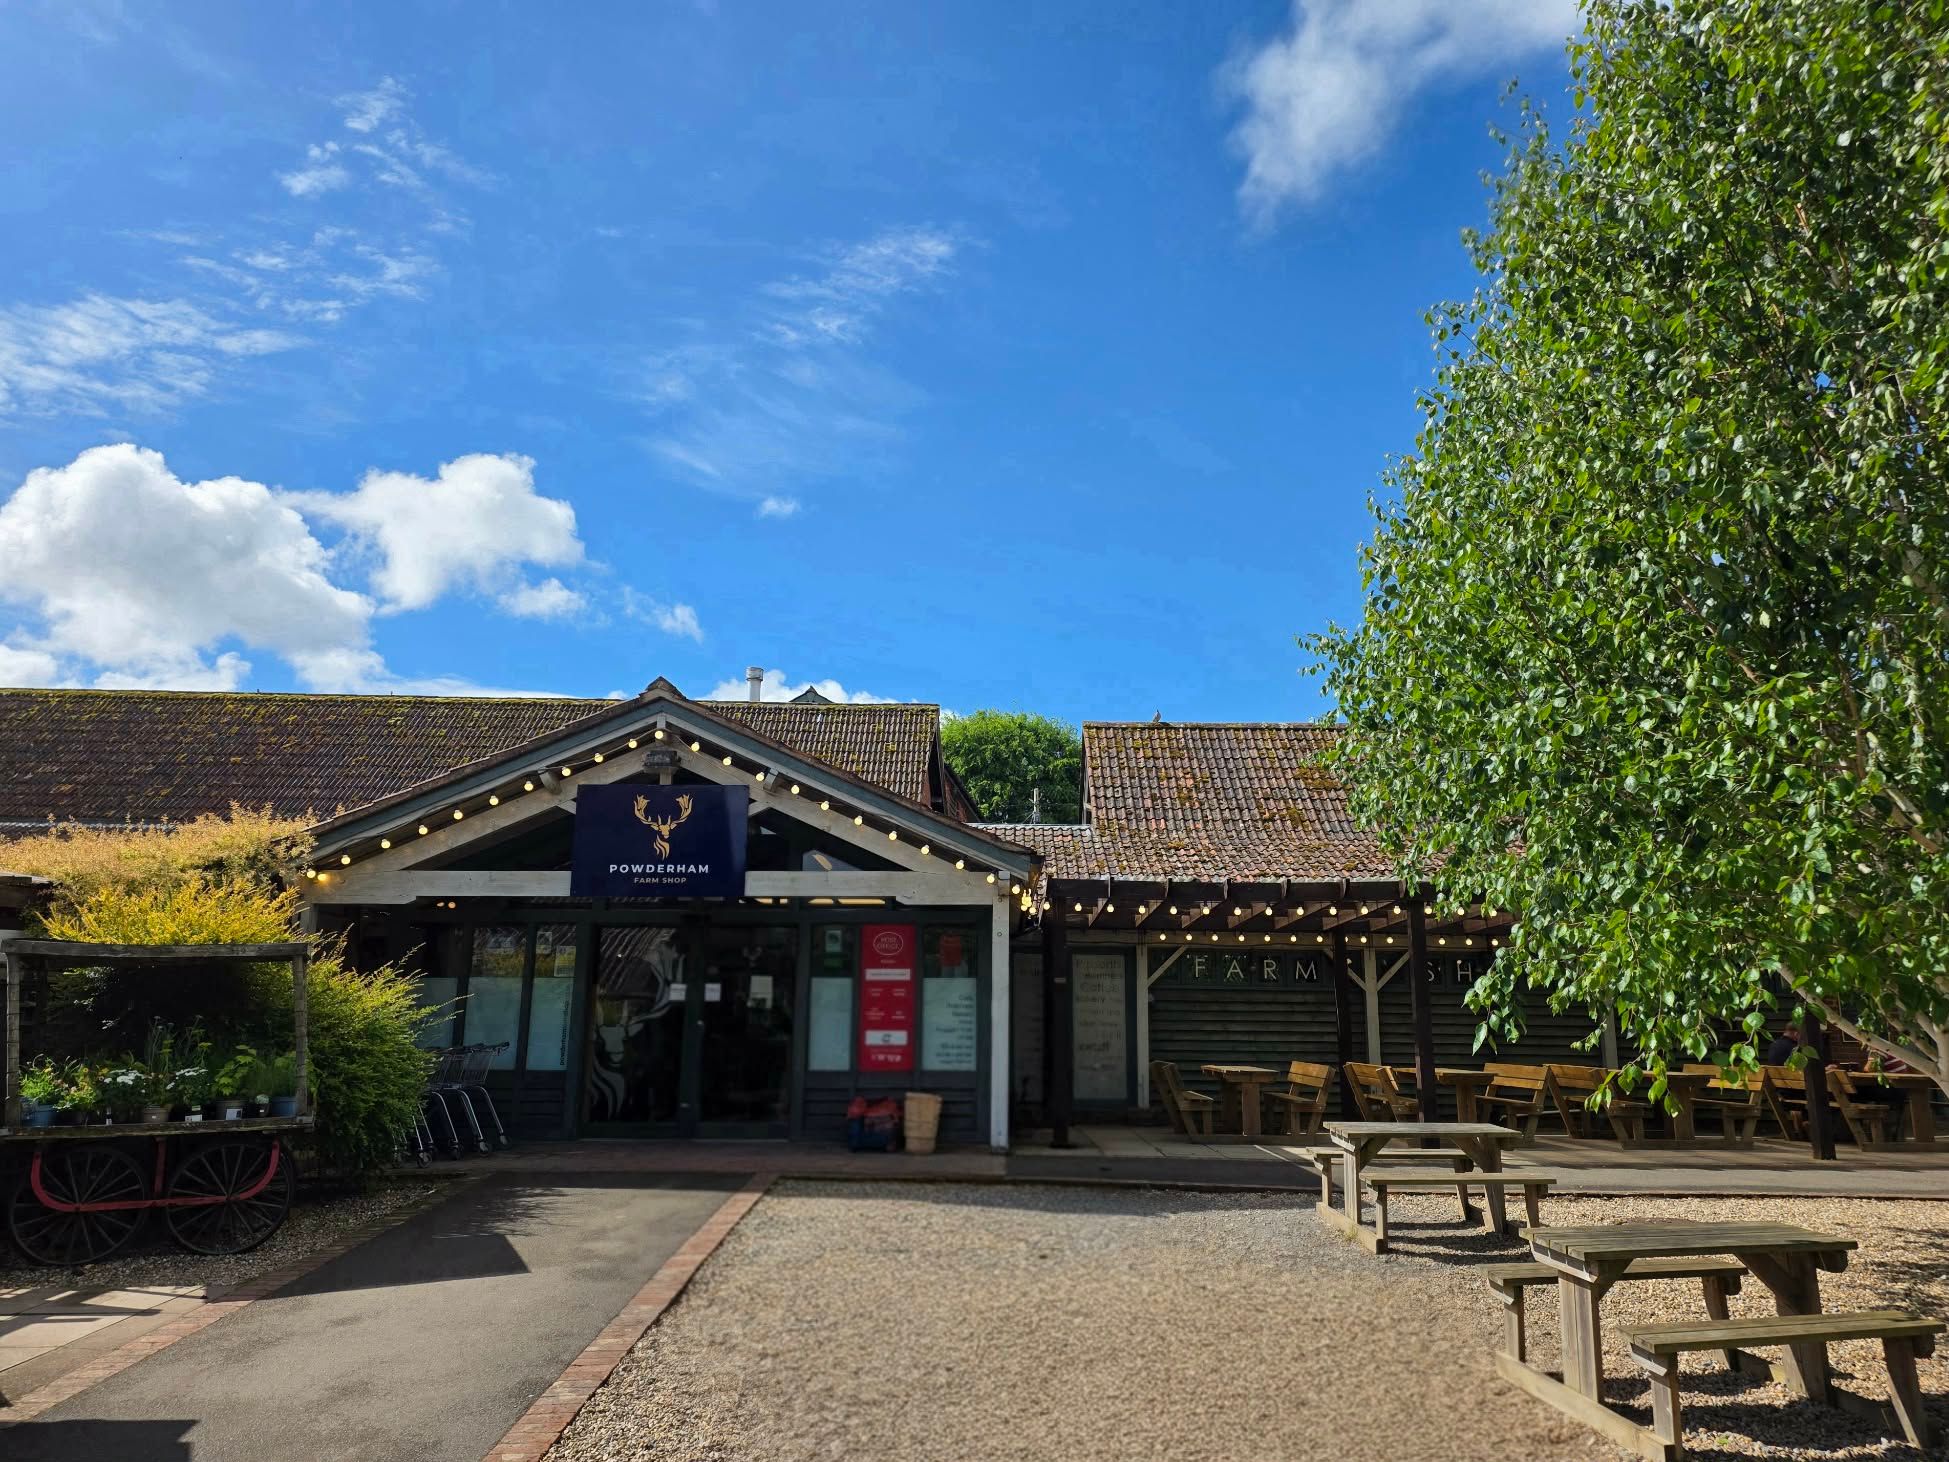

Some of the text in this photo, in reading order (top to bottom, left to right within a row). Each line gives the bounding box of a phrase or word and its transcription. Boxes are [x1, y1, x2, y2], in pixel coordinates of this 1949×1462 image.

[609, 864, 709, 874] POWDERHAM
[1194, 958, 1473, 982] FARM SH
